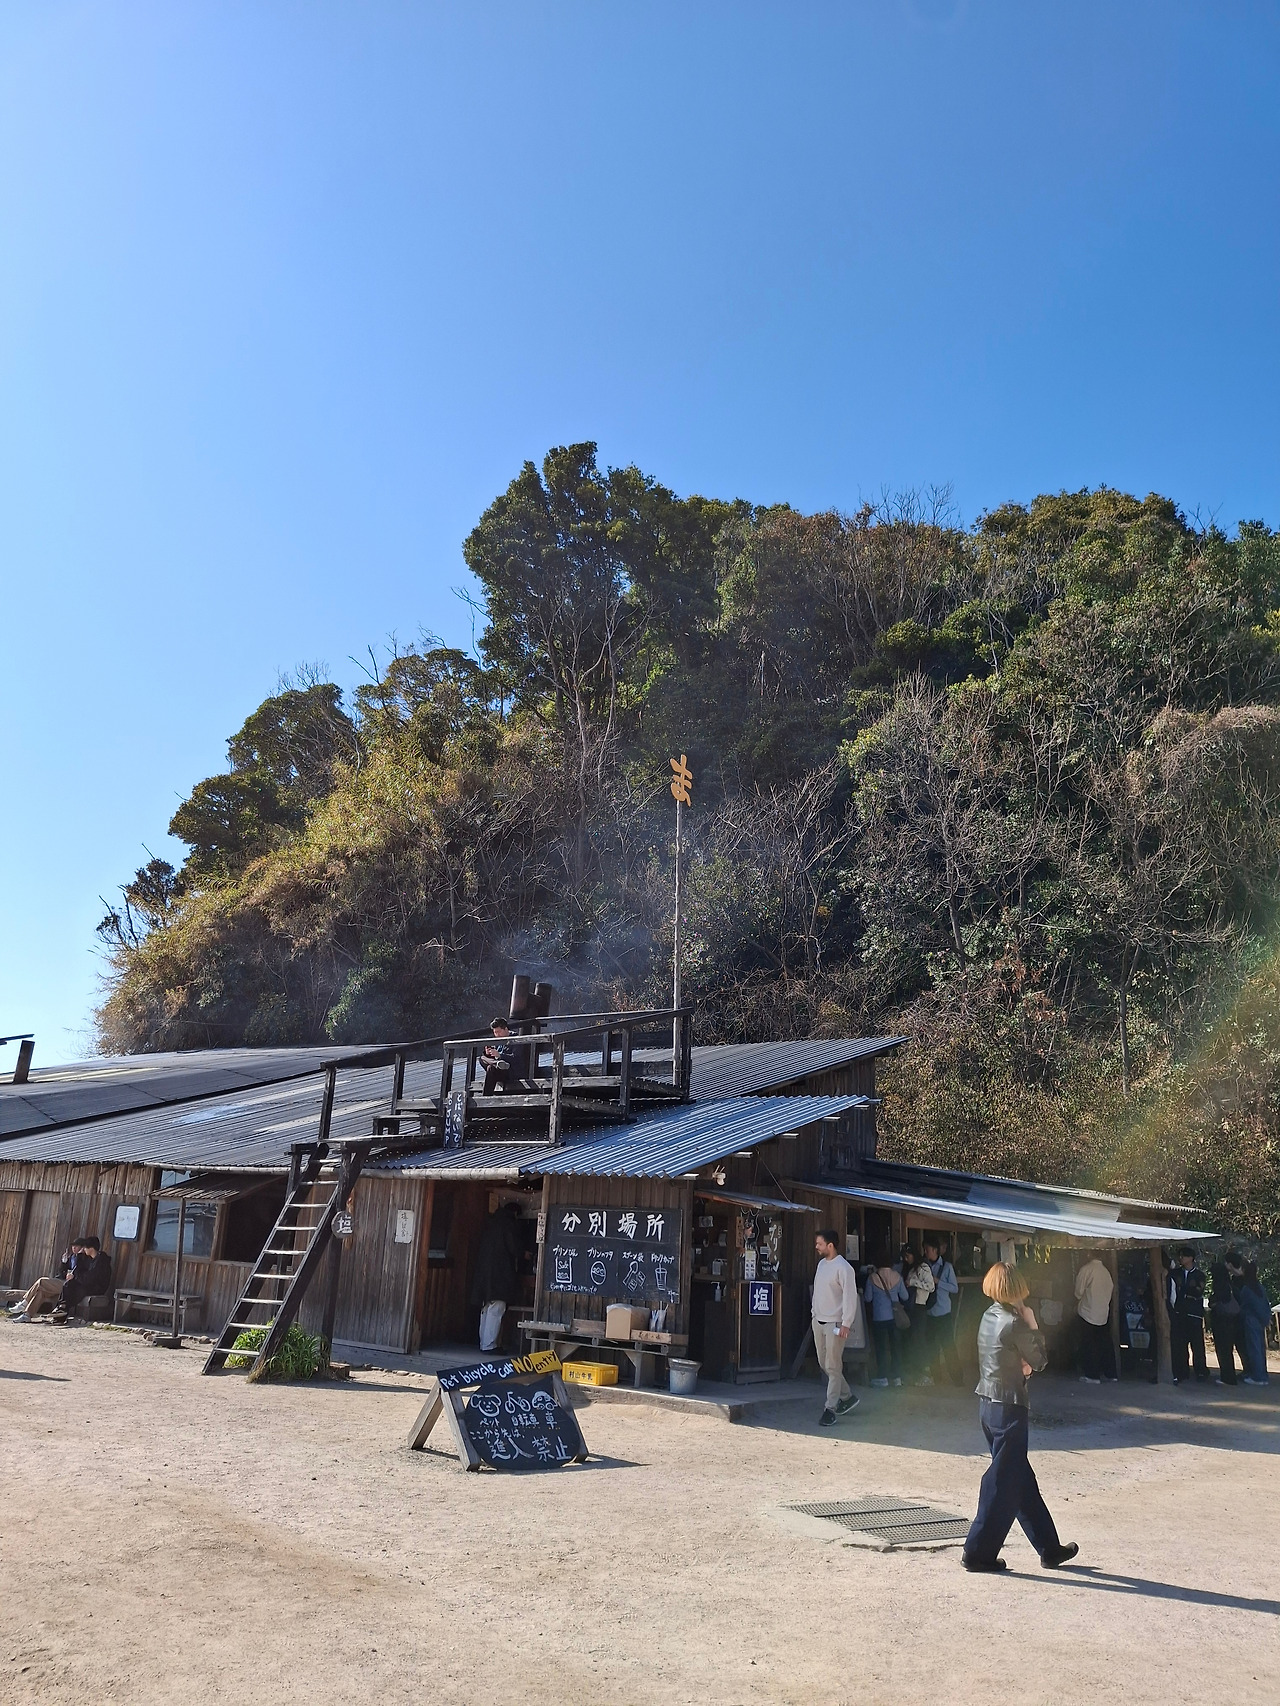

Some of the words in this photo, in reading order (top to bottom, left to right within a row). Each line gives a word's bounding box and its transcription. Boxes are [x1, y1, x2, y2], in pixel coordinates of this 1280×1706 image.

[336, 1214, 353, 1234] 塩
[561, 1210, 665, 1242] 分別場所
[753, 1287, 770, 1311] 塩
[440, 1374, 460, 1390] Pet
[459, 1363, 497, 1384] bicycle
[498, 1362, 514, 1378] car
[511, 1356, 534, 1374] NO
[535, 1351, 558, 1371] entry
[480, 1418, 500, 1427] ペット
[511, 1412, 540, 1426] 自転車
[545, 1411, 558, 1429] 車
[487, 1436, 572, 1462] 進入禁止
